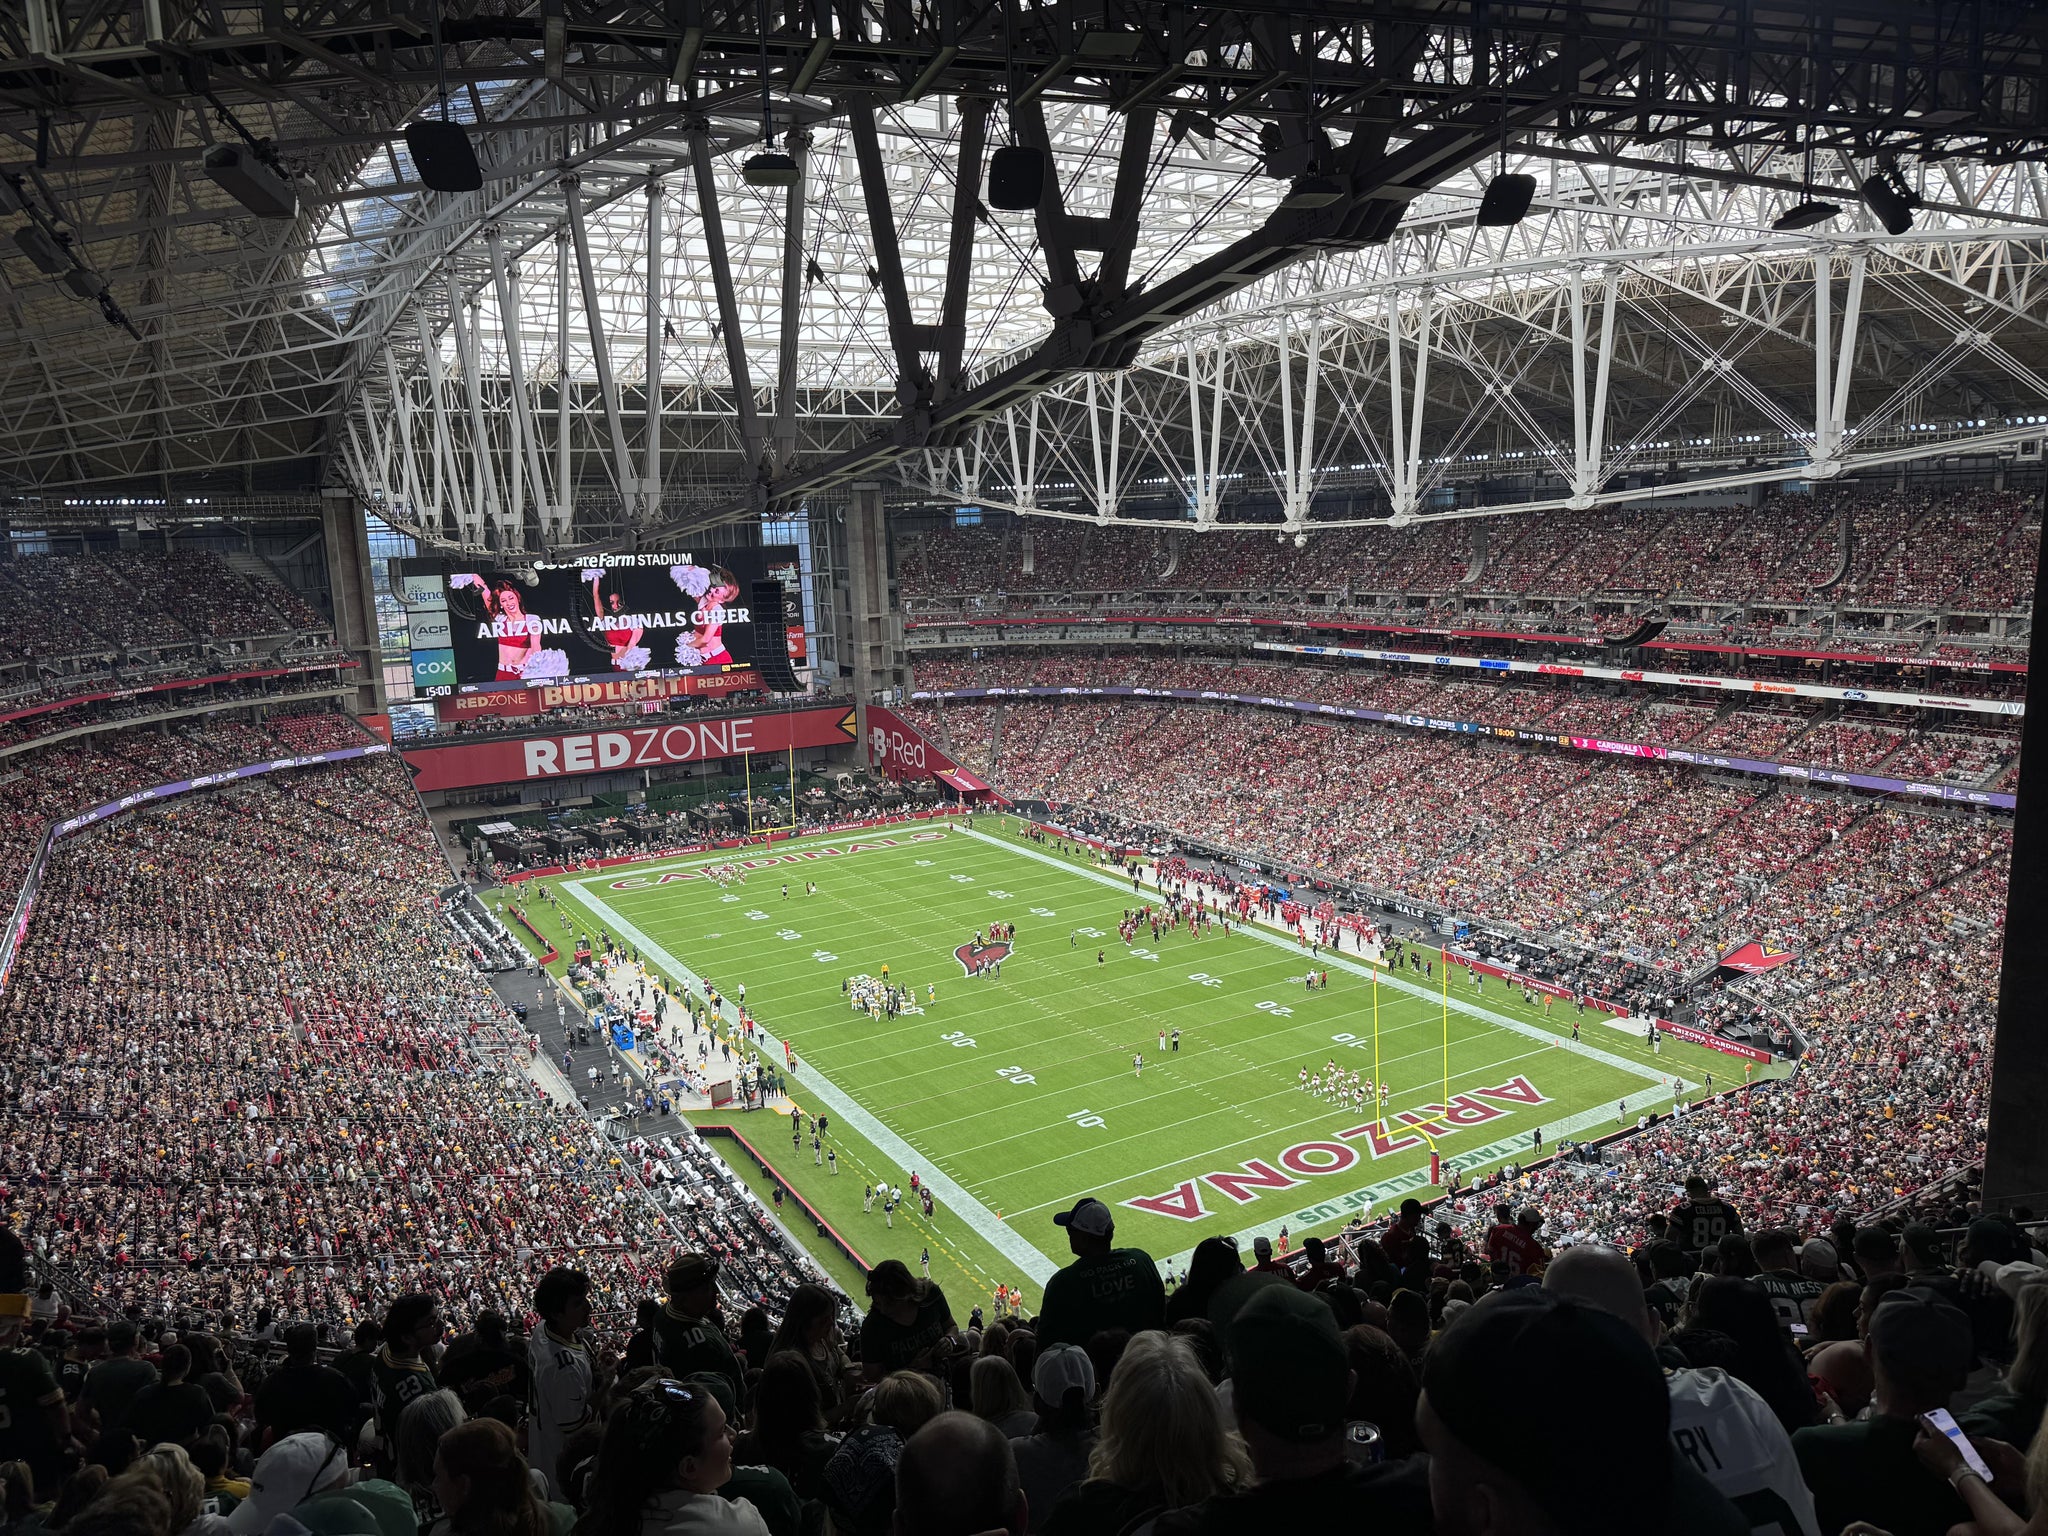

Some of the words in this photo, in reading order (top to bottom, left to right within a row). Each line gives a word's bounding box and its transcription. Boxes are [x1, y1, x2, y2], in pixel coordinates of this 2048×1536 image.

[638, 553, 693, 567] STADIUM
[407, 589, 445, 603] cigna
[417, 625, 449, 635] ACP
[477, 618, 574, 639] ARIZONA
[582, 610, 687, 632] CARDINALS
[690, 607, 751, 626] CHEER
[416, 661, 453, 675] COX
[1885, 656, 1903, 664] DICK
[1906, 657, 1933, 666] (NIGHT
[1936, 659, 1965, 668] TRAIN)
[696, 673, 757, 689] REDZONE
[114, 689, 133, 697] ADRIAN
[134, 686, 153, 694] WILSON
[426, 685, 452, 697] 15:00
[544, 683, 601, 706] BUD
[606, 676, 681, 700] LIGHT
[456, 692, 527, 709] REDZONE
[1429, 719, 1456, 728] PACKERS
[1462, 723, 1468, 731] 0
[1494, 728, 1515, 737] 15:00
[524, 717, 756, 777] REDZONE
[892, 731, 926, 769] Red
[1597, 741, 1638, 752] CARDINALS
[802, 827, 828, 836] ARIZO
[831, 822, 864, 831] CARDINALS
[664, 846, 701, 857] CARDINALS
[744, 909, 770, 921] 20
[776, 928, 803, 941] 30
[811, 949, 839, 963] 40
[1188, 972, 1223, 988] 30
[1528, 981, 1560, 994] CARDINALS
[1255, 1000, 1295, 1018] 20
[941, 1030, 977, 1048] 30
[1331, 1032, 1367, 1050] 10
[1671, 1026, 1707, 1042] ARIZONA
[1709, 1038, 1756, 1057] CARDINALS
[995, 1065, 1036, 1085] 20
[1066, 1108, 1105, 1128] 10
[1115, 1073, 1556, 1223] ARIZONA
[1510, 1133, 1535, 1150] IT
[1444, 1147, 1513, 1173] TAKE
[1376, 1171, 1429, 1194] ALL
[1343, 1190, 1376, 1209] OF
[1295, 1202, 1341, 1224] US
[1693, 1216, 1727, 1248] 89
[1091, 1274, 1136, 1298] LOVE
[1764, 1280, 1788, 1295] VAN
[1791, 1280, 1823, 1296] NESS
[682, 1326, 707, 1349] 10
[554, 1349, 576, 1370] 10
[395, 1374, 423, 1401] 23
